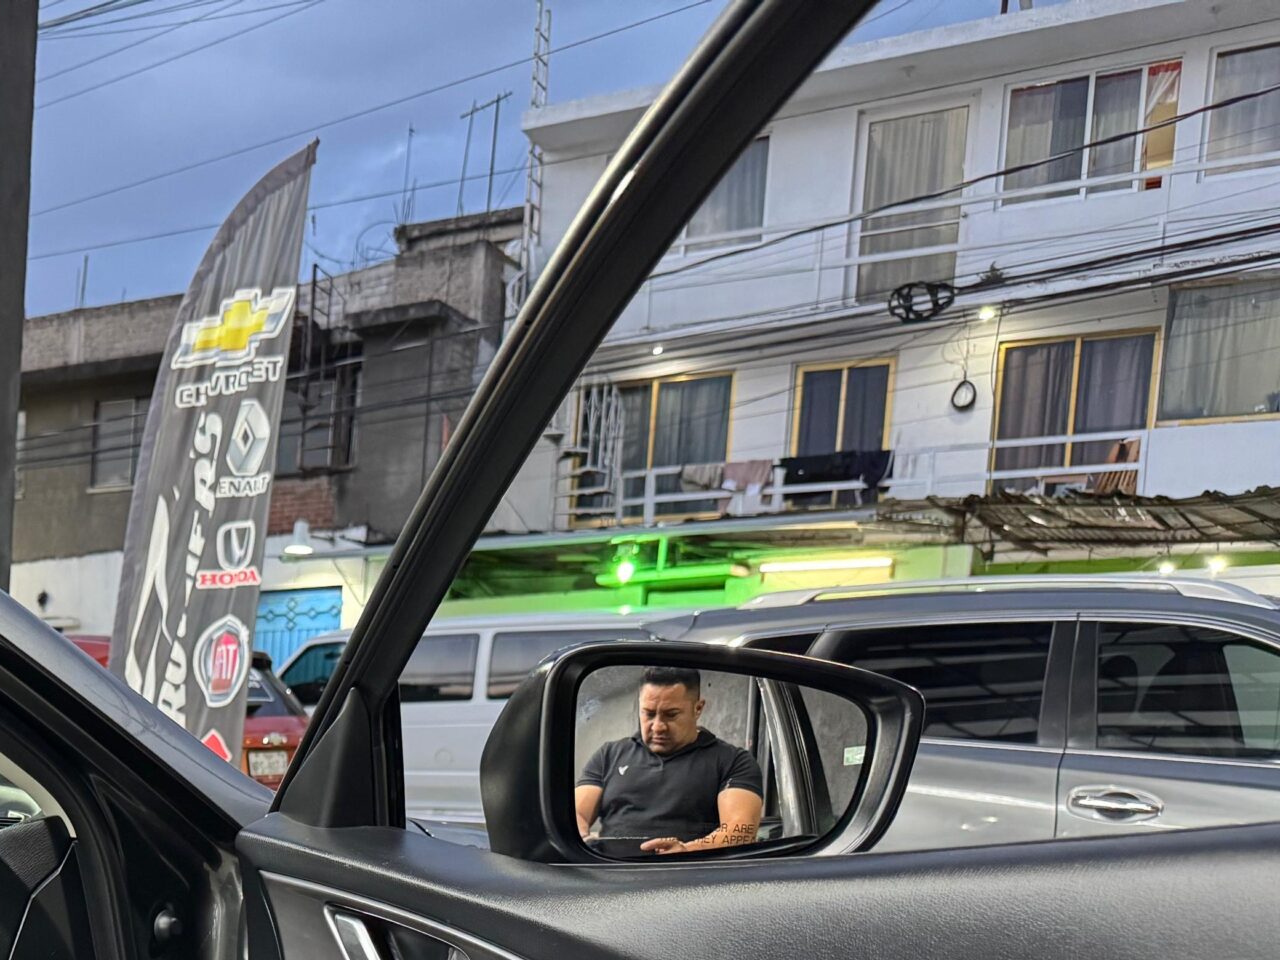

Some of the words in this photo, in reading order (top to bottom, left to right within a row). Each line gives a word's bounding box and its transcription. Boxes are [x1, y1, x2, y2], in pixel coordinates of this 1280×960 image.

[176, 357, 283, 407] CHVRET
[198, 568, 259, 587] HODA
[732, 823, 755, 834] ARE
[721, 835, 758, 845] APPEA
